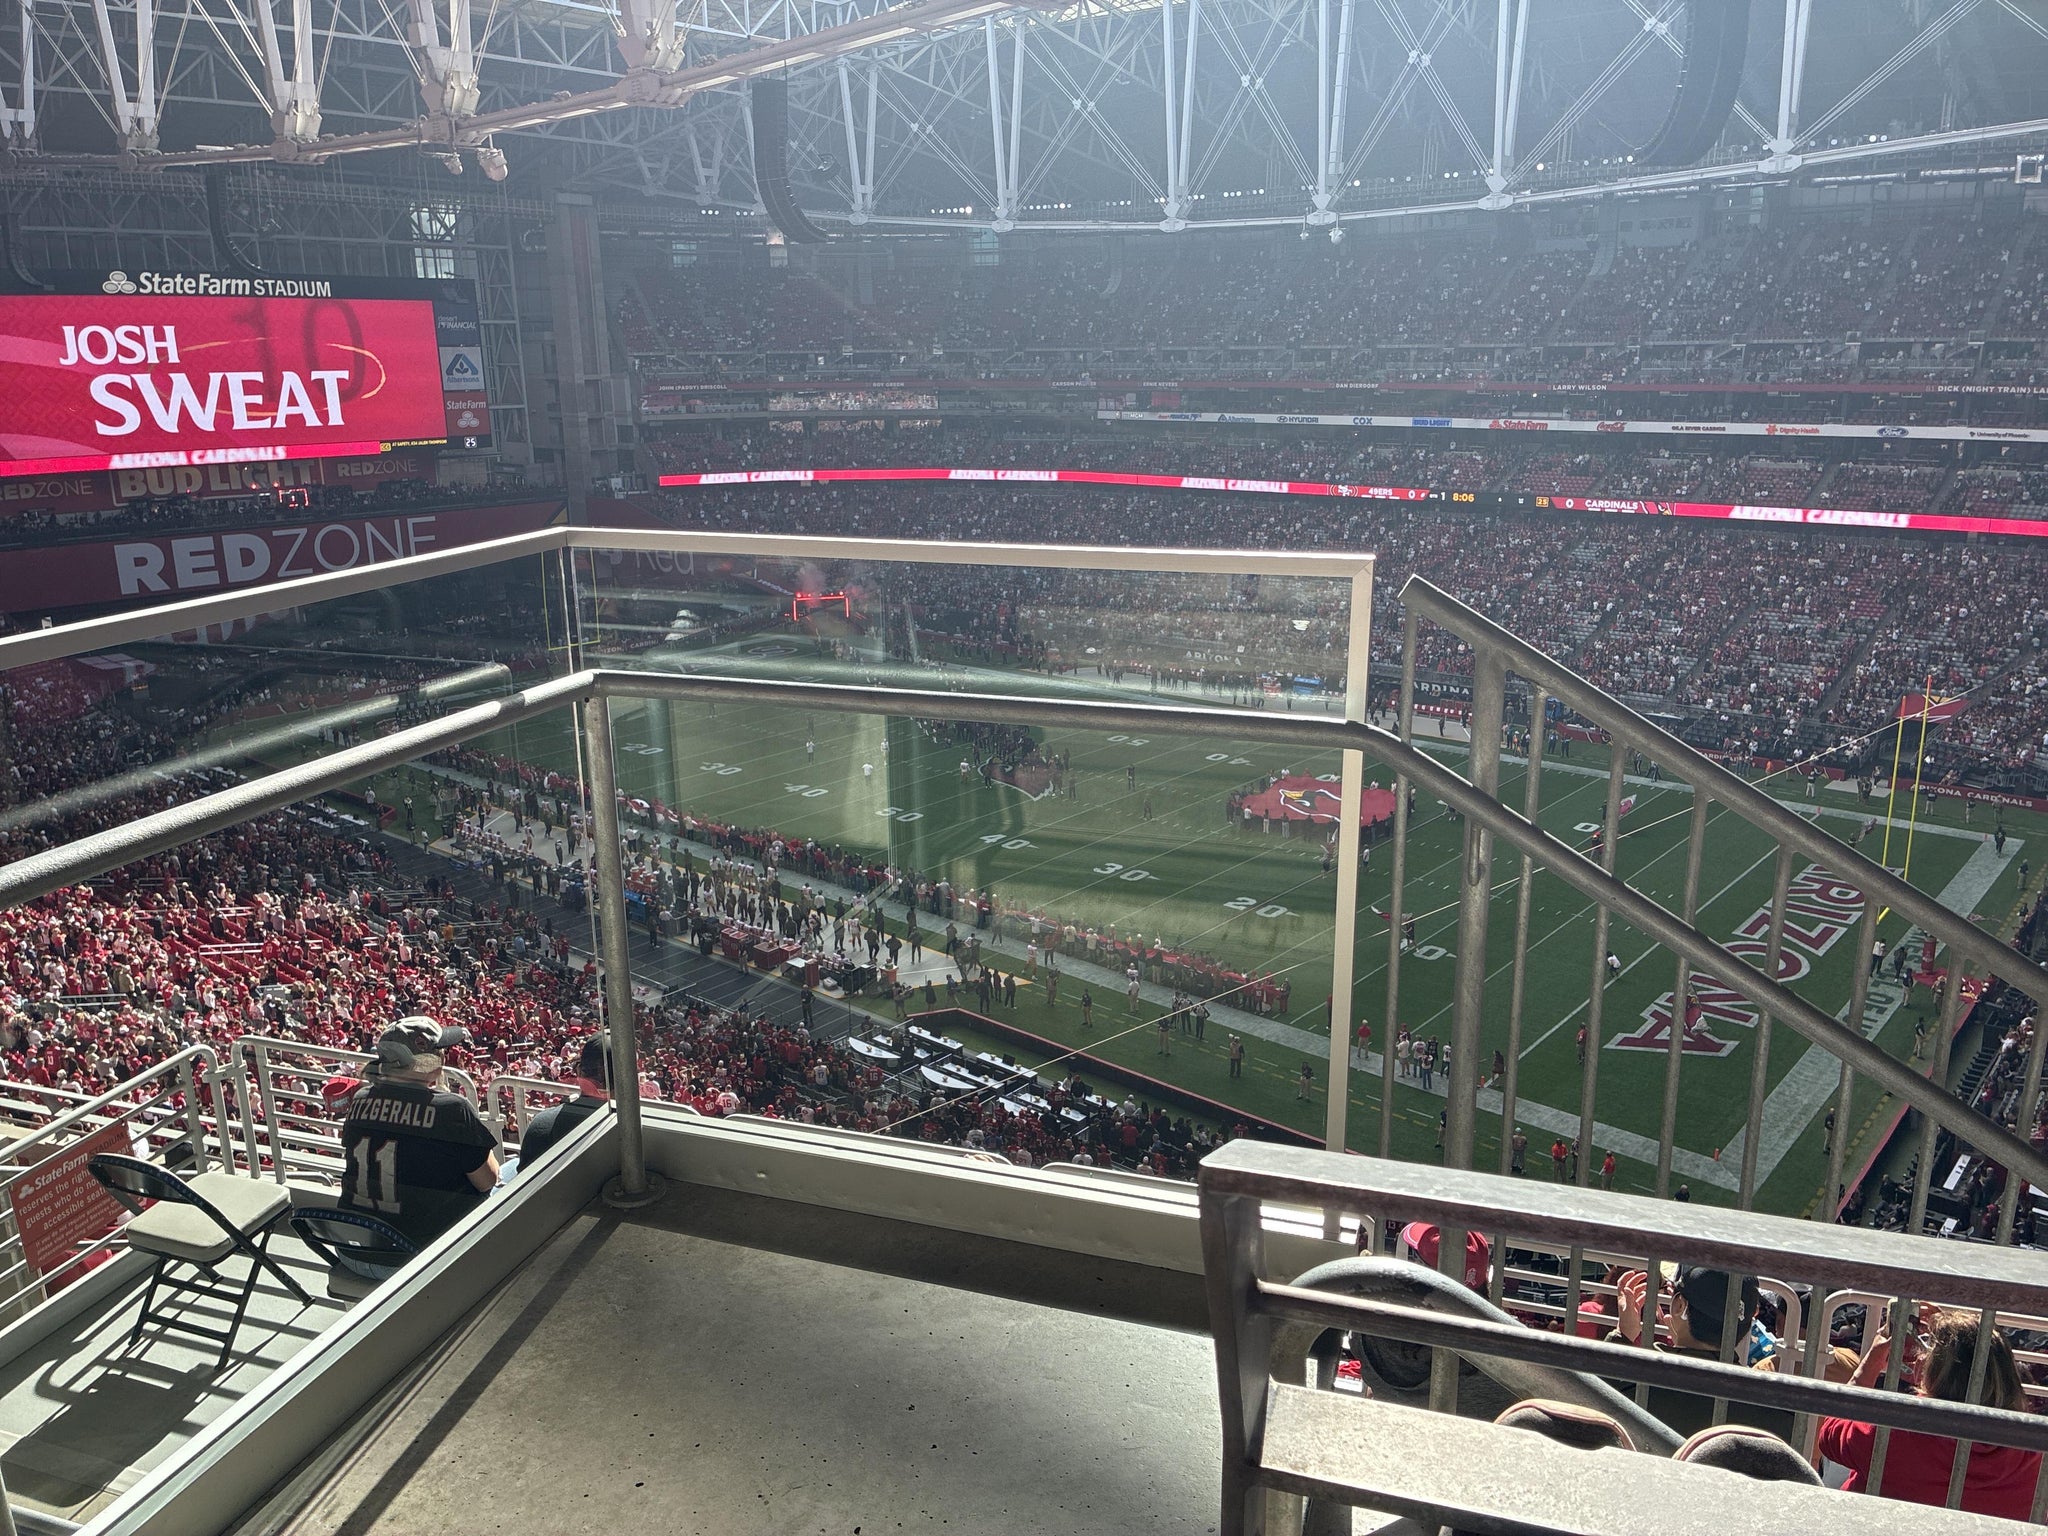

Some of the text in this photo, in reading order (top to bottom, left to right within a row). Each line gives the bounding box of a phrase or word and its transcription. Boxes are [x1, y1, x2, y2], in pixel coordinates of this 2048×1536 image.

[253, 279, 332, 297] STADIUM
[59, 325, 180, 366] JOSH
[1997, 386, 2031, 394] TRAIN)
[89, 370, 350, 436] SWEAT
[1352, 417, 1373, 425] COX
[337, 457, 418, 478] REDZONE
[118, 458, 317, 498] BUD LIGHT
[0, 479, 94, 501] EDZONE
[1368, 487, 1416, 499] 49ERS 0
[1452, 493, 1475, 502] 8:06
[1565, 499, 1638, 510] 0 CARDINALS
[114, 516, 437, 595] REDZONE
[374, 683, 412, 696] ARIZON
[1413, 681, 1470, 696] ARDINA
[1967, 791, 2033, 808] CARDNALS
[875, 806, 924, 822] 50
[979, 833, 1033, 851] 40
[1093, 862, 1151, 881] 30
[1223, 896, 1289, 918] 20
[722, 1099, 732, 1108] 16
[351, 1136, 400, 1214] 11
[18, 1191, 54, 1216] reserves
[55, 1180, 70, 1194] the
[24, 1205, 52, 1229] guests
[53, 1191, 72, 1209] who
[73, 1183, 84, 1198] do
[43, 1199, 85, 1230] accessible
